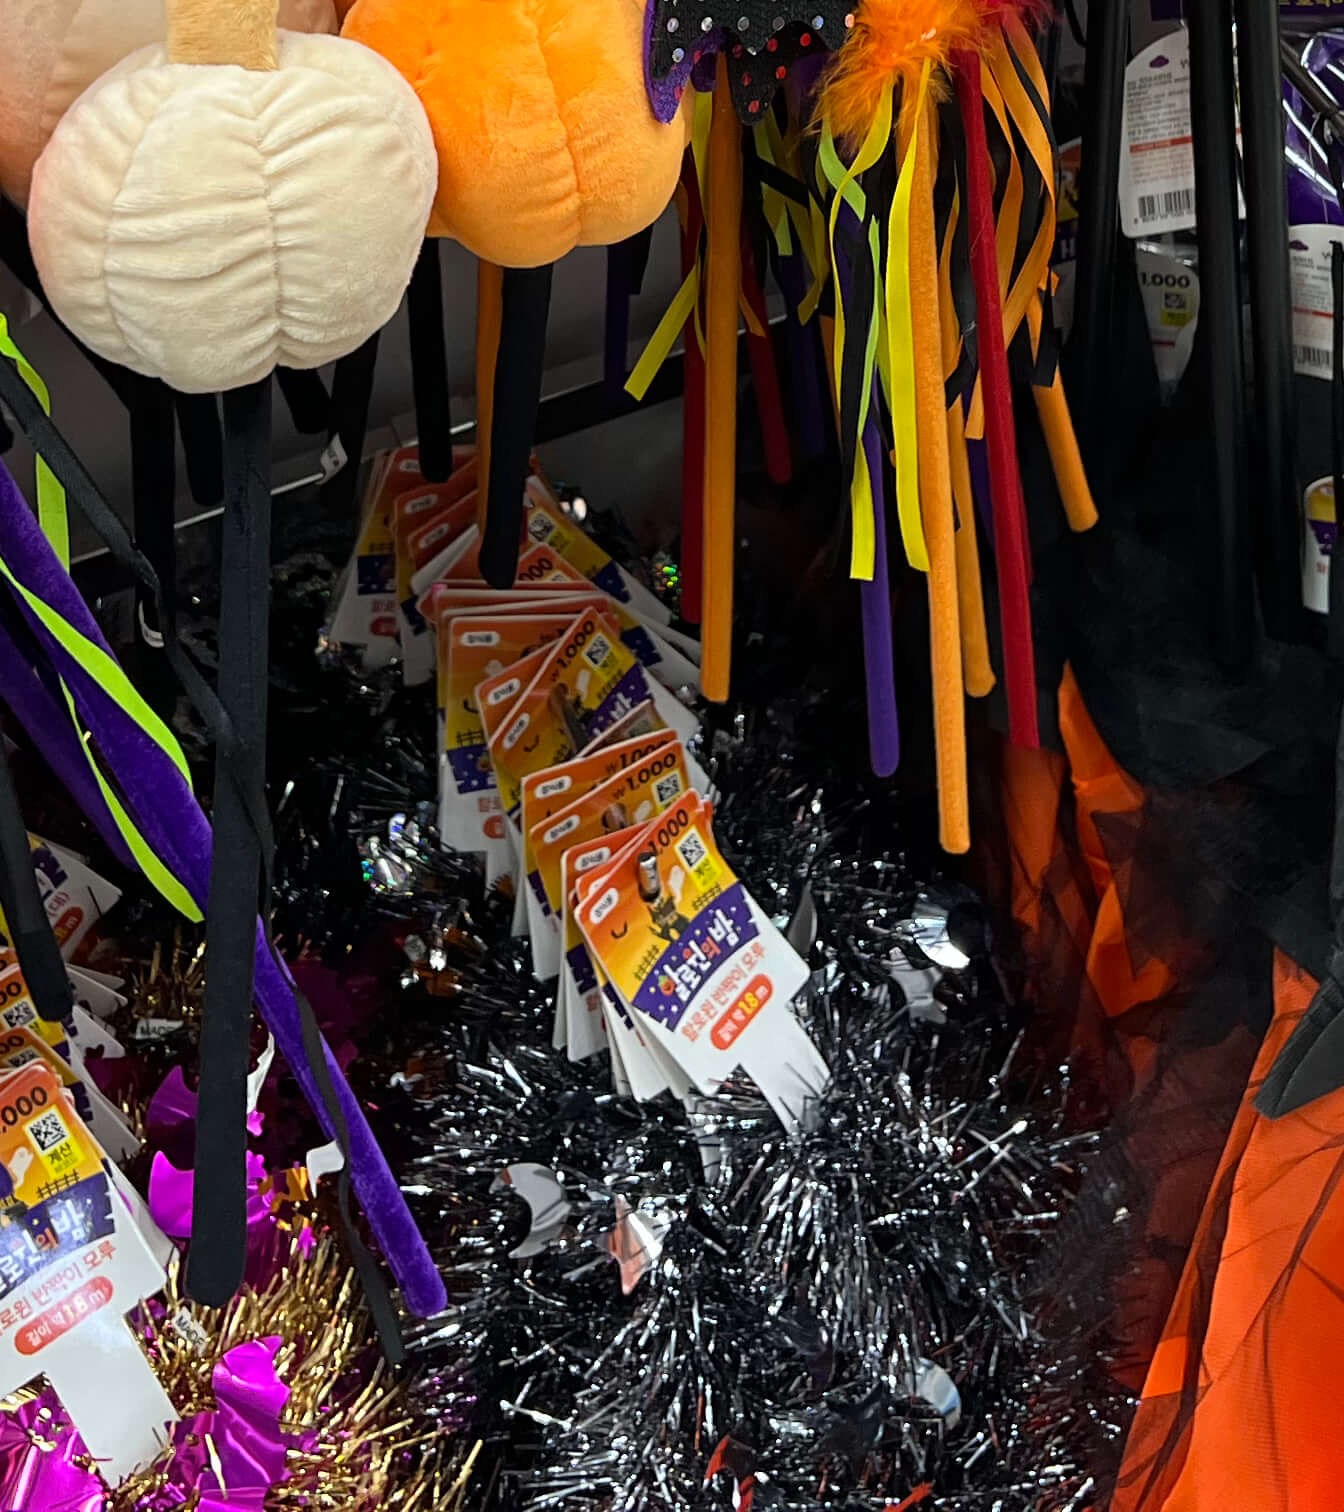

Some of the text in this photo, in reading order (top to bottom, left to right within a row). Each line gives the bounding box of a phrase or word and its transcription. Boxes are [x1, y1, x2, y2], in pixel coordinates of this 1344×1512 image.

[707, 908, 740, 947] 밤
[46, 1142, 73, 1165] 계산
[51, 1198, 86, 1241] 밤
[81, 1238, 118, 1272] 모루
